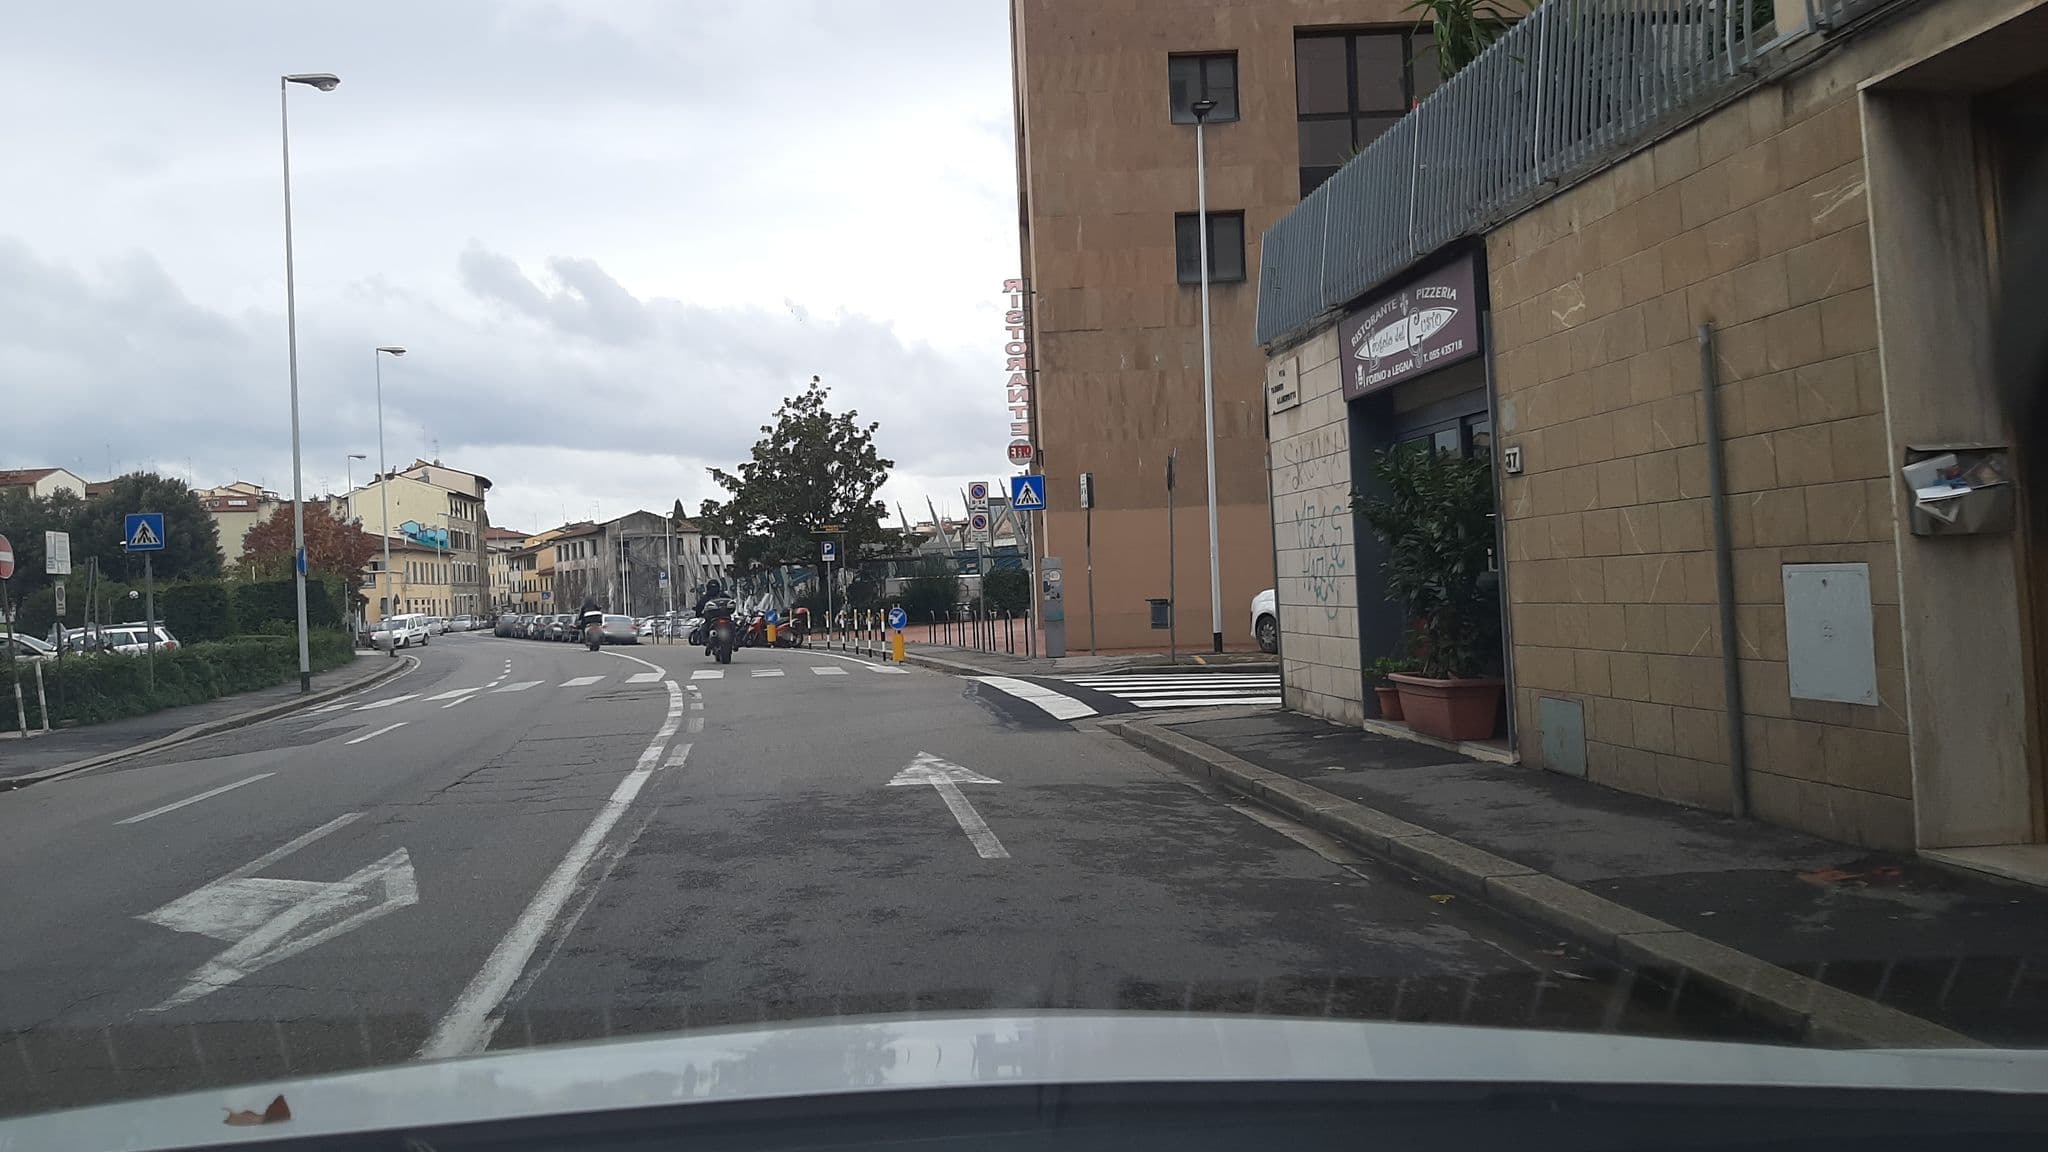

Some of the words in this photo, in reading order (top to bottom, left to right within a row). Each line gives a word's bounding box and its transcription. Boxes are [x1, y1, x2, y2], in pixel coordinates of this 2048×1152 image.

[1351, 299, 1398, 347] RISTORANTE
[1416, 286, 1457, 300] PIZZERIA
[1391, 359, 1413, 376] LEGNA
[1505, 452, 1517, 468] 37
[824, 543, 832, 554] P
